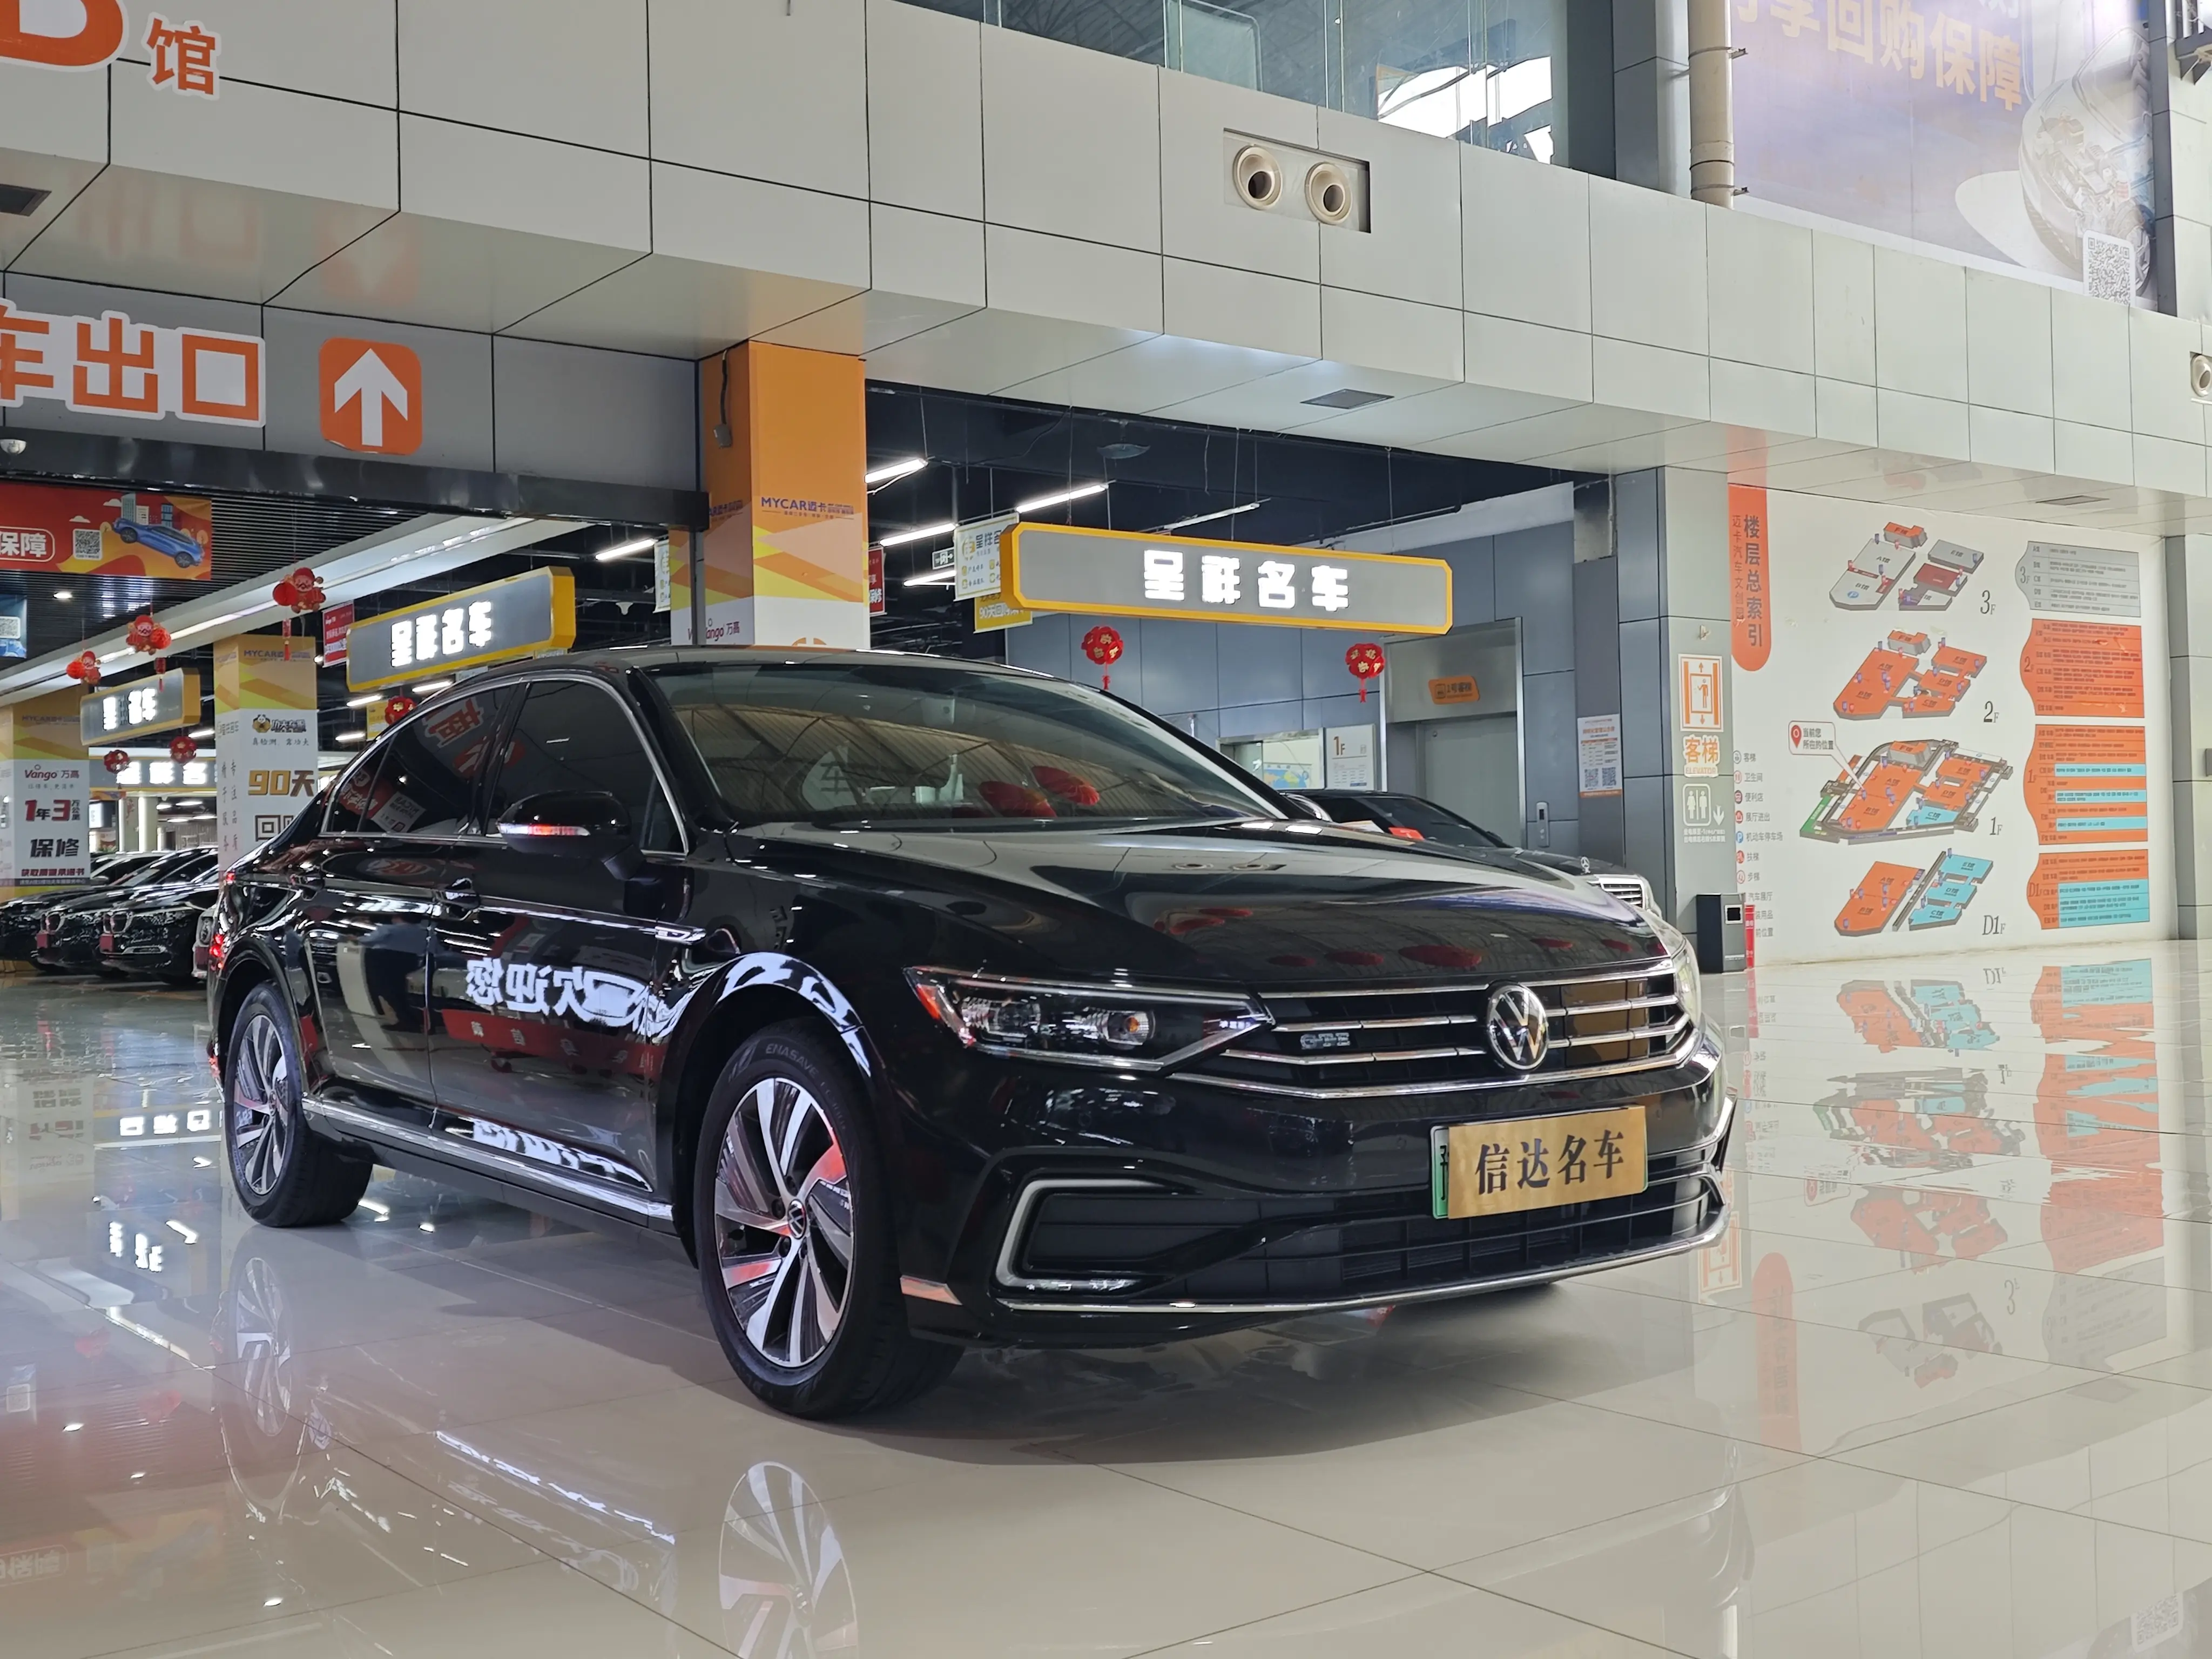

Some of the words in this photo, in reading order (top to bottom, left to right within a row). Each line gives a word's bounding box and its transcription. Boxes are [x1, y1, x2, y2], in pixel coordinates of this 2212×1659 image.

[146, 18, 216, 95] 馆
[1737, 0, 2022, 111] 回购保障
[0, 531, 46, 558] 保障
[1743, 514, 1763, 647] 楼层总索引
[1980, 590, 1995, 616] 3F
[1984, 700, 1999, 723] 2F
[1333, 736, 1345, 756] 1F
[1685, 737, 1719, 764] 客梯
[24, 769, 57, 781] Vango
[60, 770, 80, 779] 万高
[247, 770, 315, 797] 90天
[1990, 816, 2003, 836] 1F
[30, 838, 79, 858] 保修
[1982, 914, 2006, 935] D1F
[766, 1043, 819, 1079] ENASAVE
[1475, 1130, 1624, 1195] 信达名车
